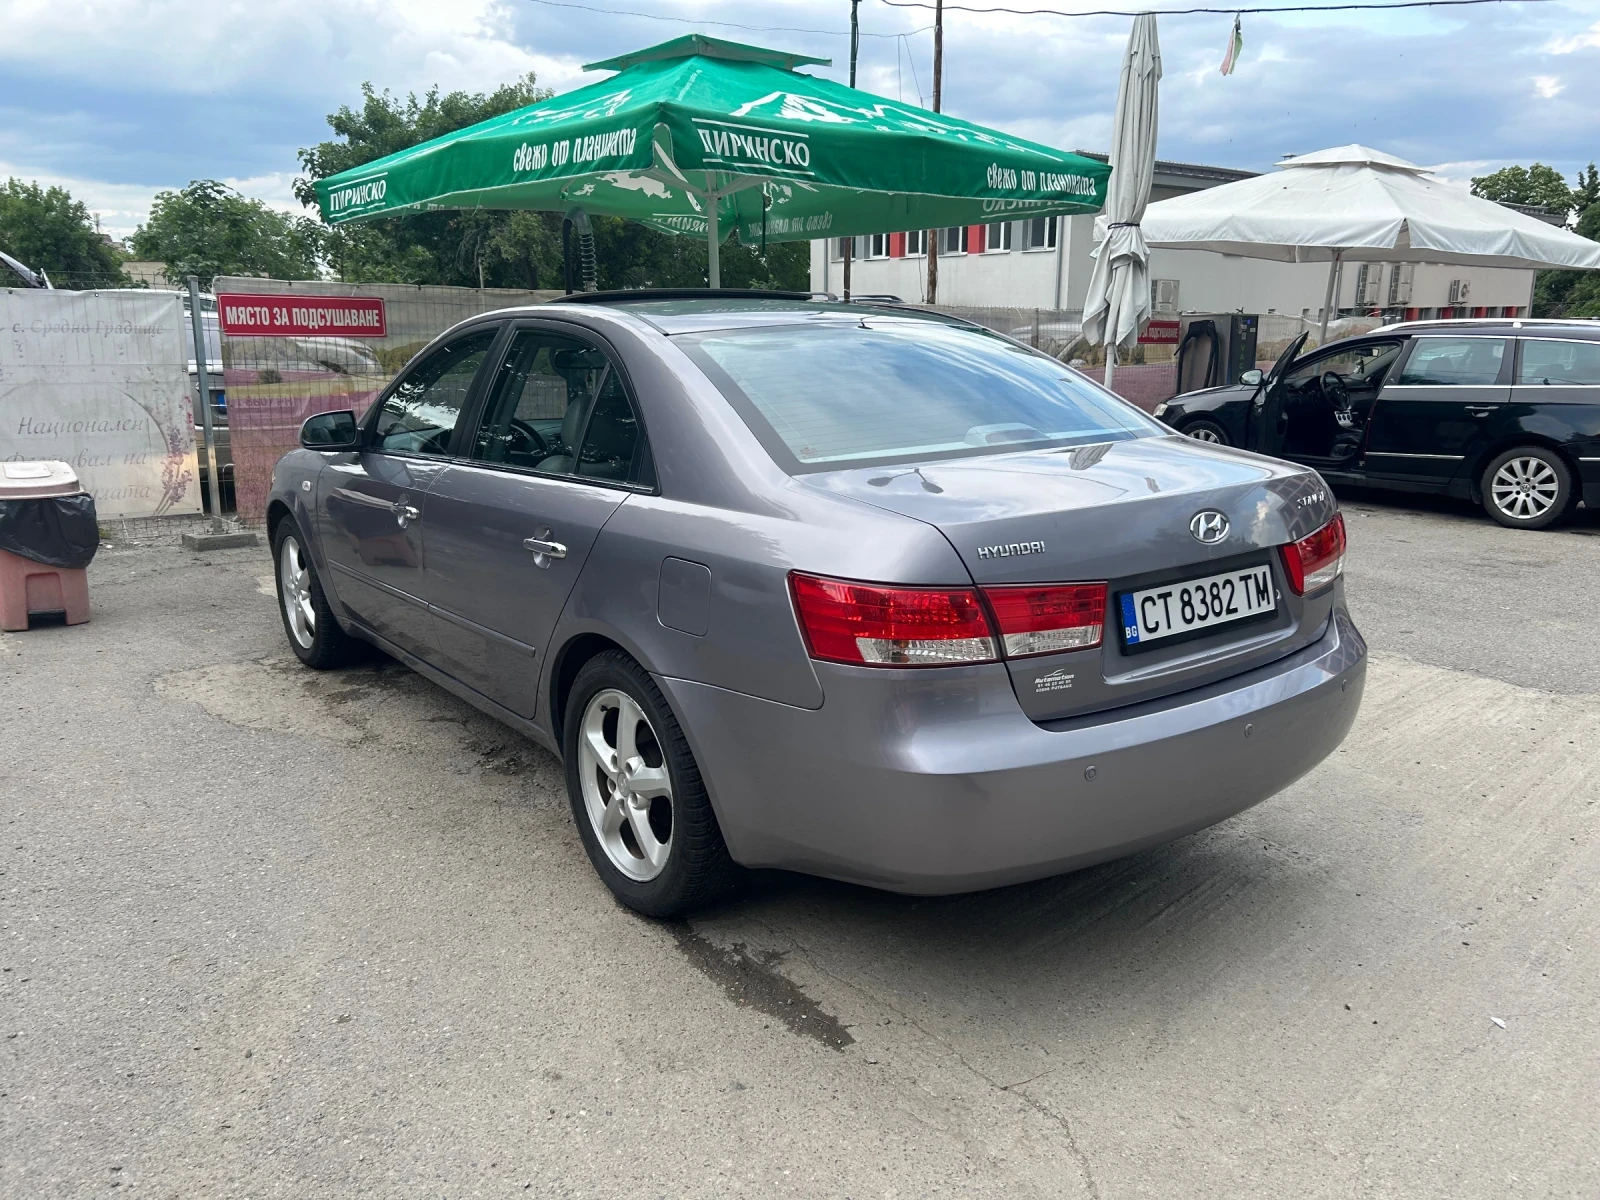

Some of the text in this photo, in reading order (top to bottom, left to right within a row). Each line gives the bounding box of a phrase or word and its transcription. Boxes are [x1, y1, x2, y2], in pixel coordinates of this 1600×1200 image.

[513, 128, 637, 172] свежо от планината
[697, 129, 810, 167] ПИРИНСКО
[987, 162, 1097, 196] свежо от планината
[330, 180, 387, 211] ПИРИНСКО
[95, 319, 164, 339] Градище
[226, 306, 380, 329] МЯСТО ЗА ПОДСУШАВАНЕ
[18, 416, 144, 438] Национален
[123, 452, 147, 465] на
[977, 541, 1045, 559] HYUNDAI
[1140, 571, 1271, 634] CT 8382 TM
[1125, 625, 1138, 639] BG
